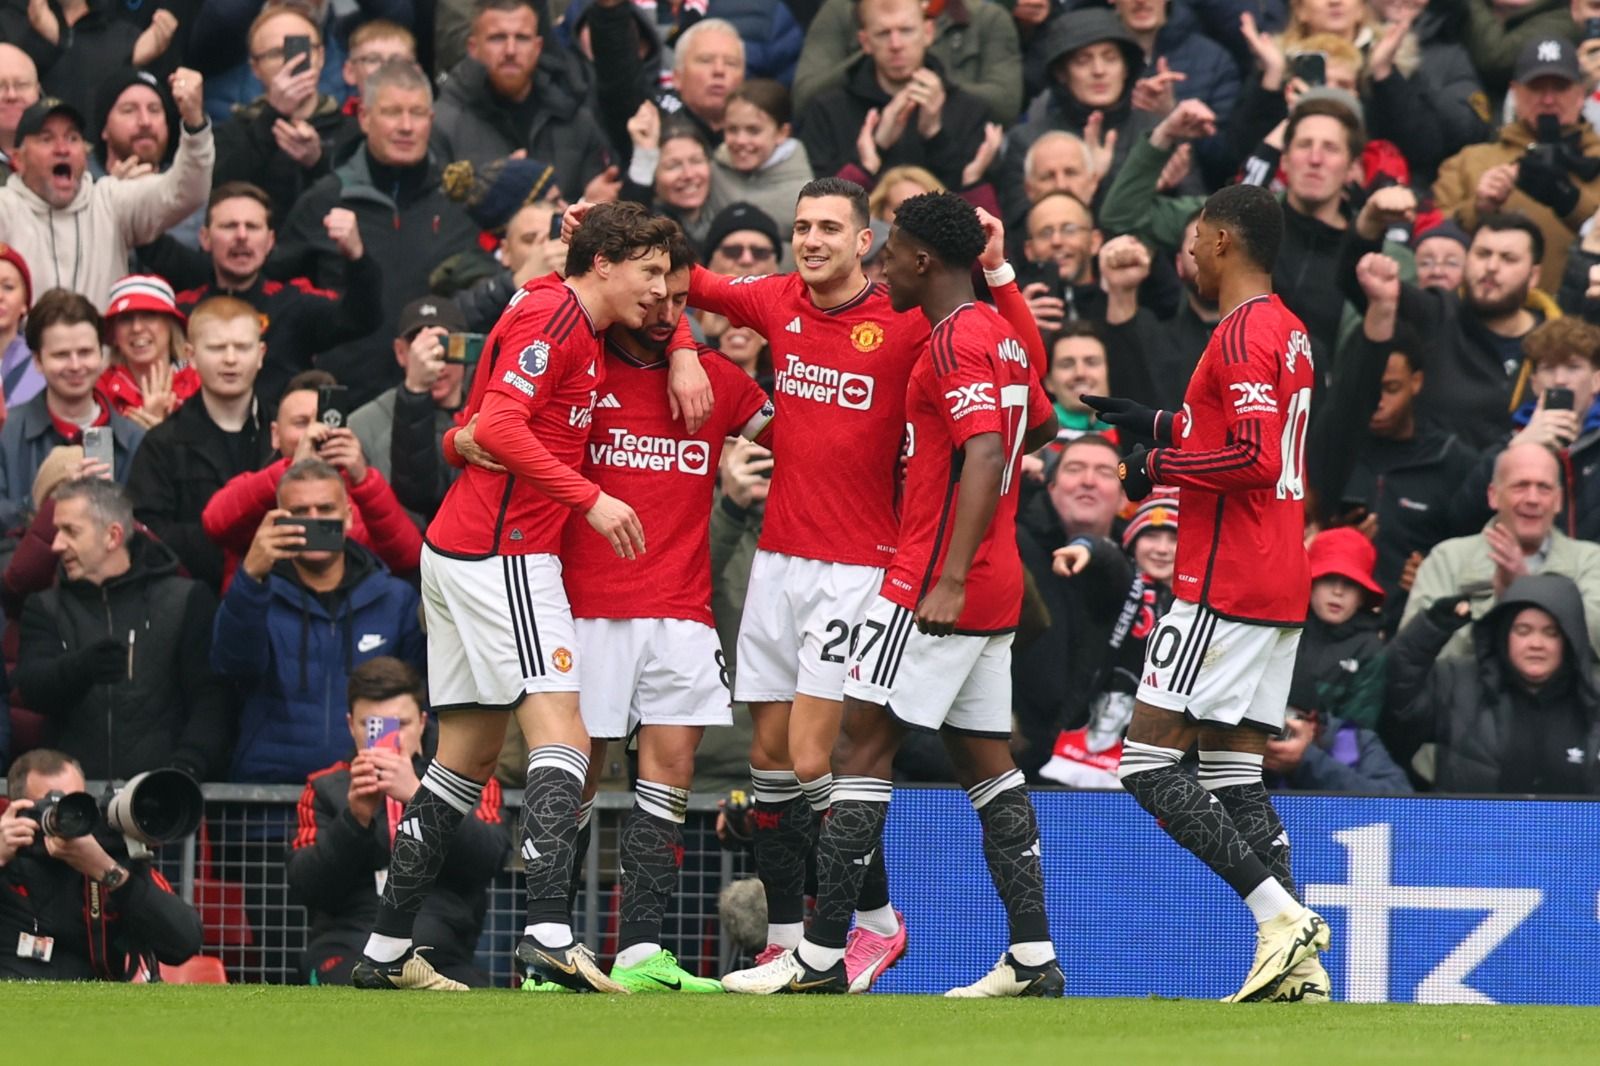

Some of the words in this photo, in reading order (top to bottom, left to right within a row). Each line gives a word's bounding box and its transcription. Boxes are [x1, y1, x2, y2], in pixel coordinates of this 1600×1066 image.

[775, 368, 837, 404] Viewer
[785, 353, 838, 386] Team
[589, 443, 676, 471] Viewer
[608, 428, 676, 455] Team
[1276, 387, 1312, 500] 10
[1109, 600, 1138, 648] HERE
[90, 880, 100, 919] Canon
